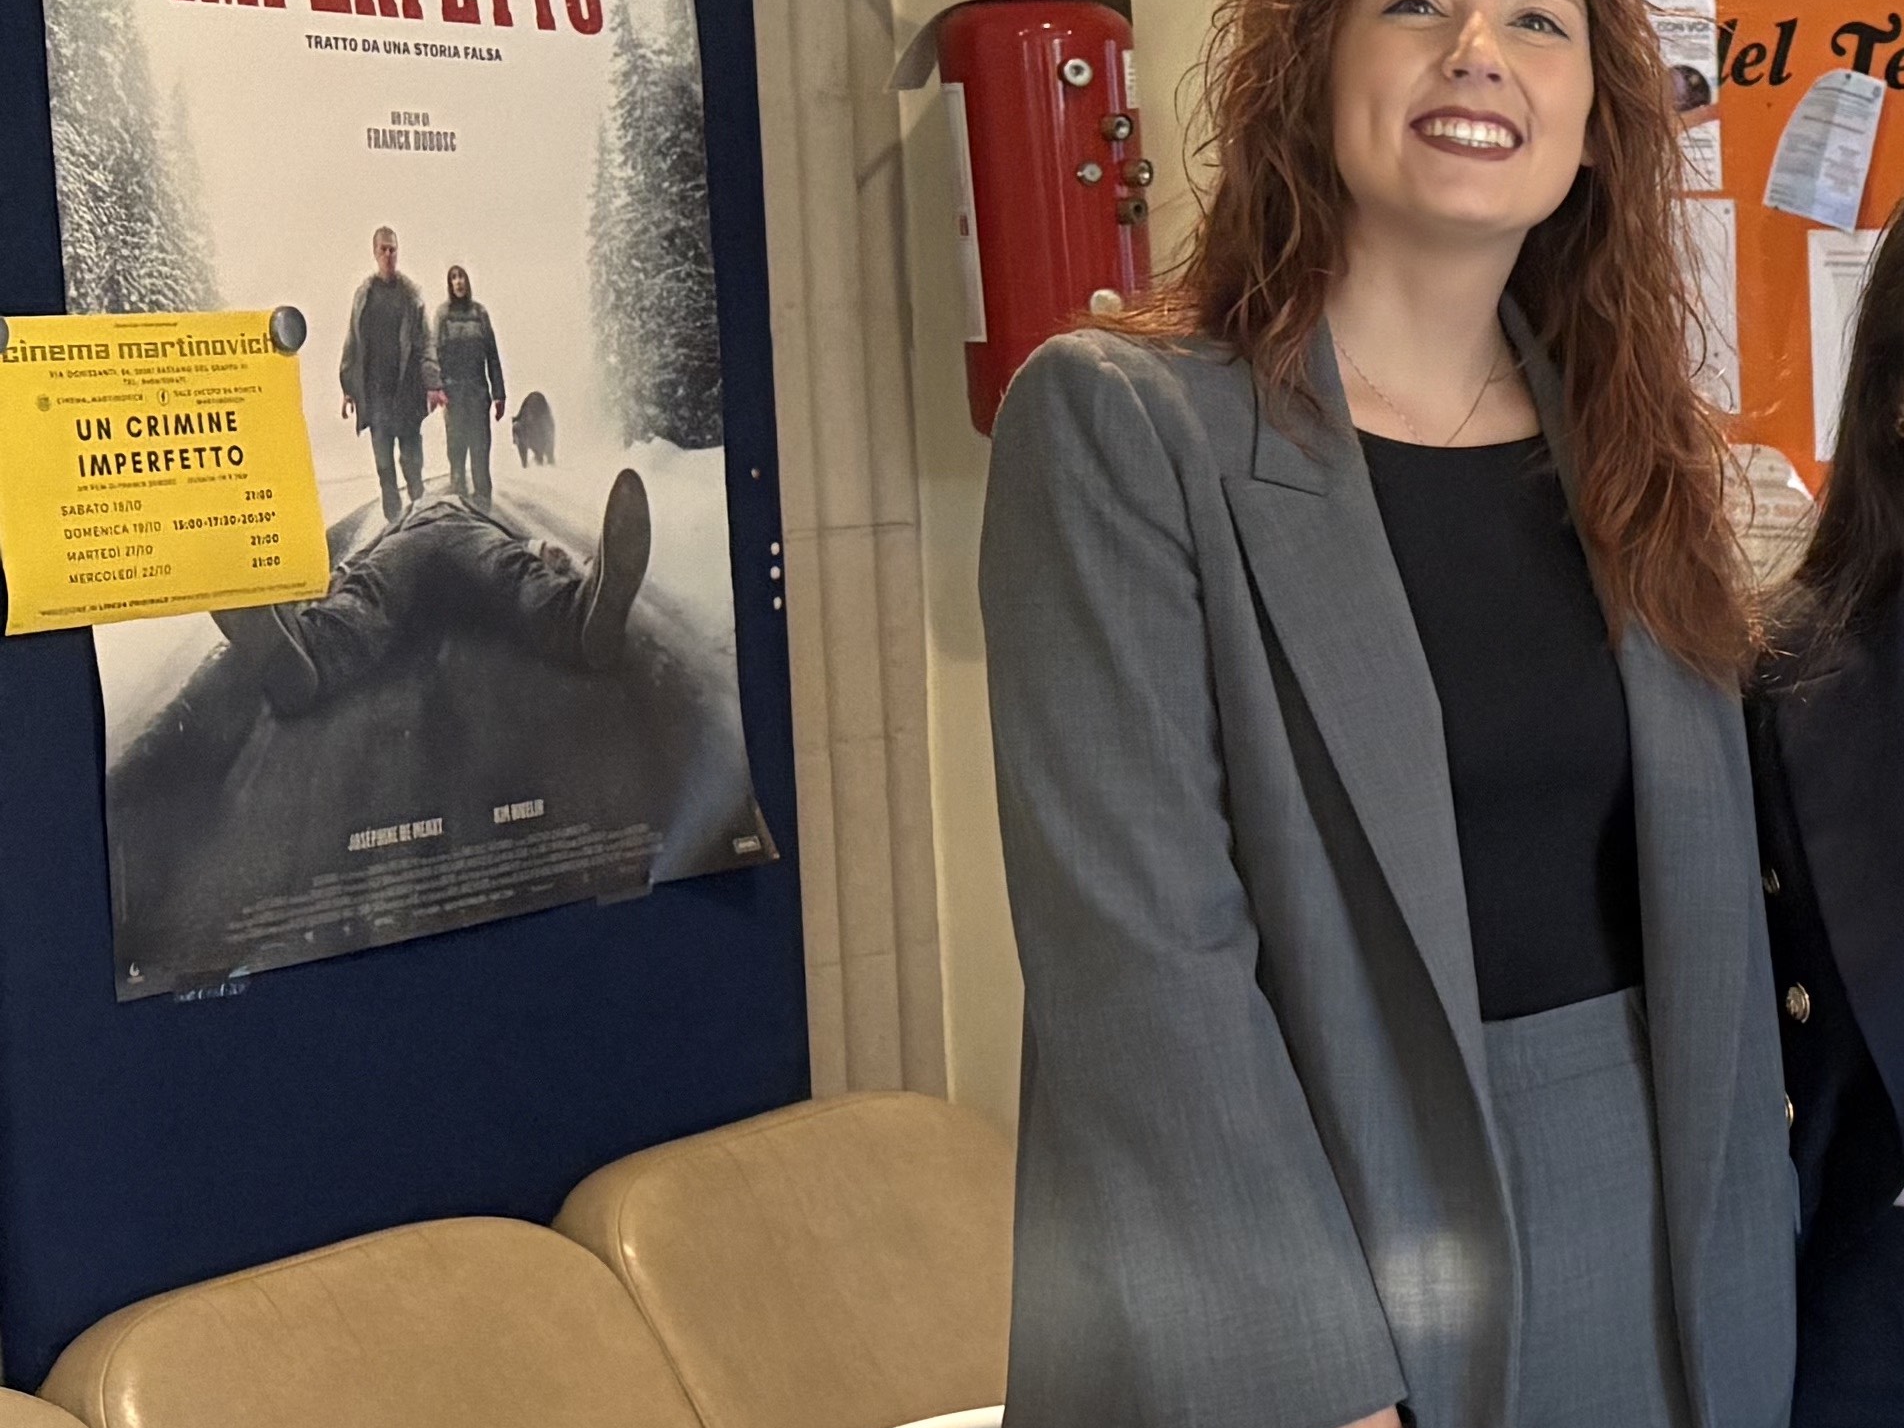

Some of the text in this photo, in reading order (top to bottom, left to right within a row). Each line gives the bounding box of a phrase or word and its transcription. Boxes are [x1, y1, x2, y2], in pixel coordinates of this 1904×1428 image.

[305, 35, 502, 61] TRATTO DA UNA STORIA FALSA
[2, 339, 110, 363] cinema
[76, 410, 238, 441] UN CRIMINE
[78, 444, 244, 478] IMPERFETTO
[61, 501, 109, 517] SABATO
[64, 523, 130, 540] DOMENICA
[67, 544, 121, 562] MARTEDÌ
[69, 565, 138, 584] MERCOLEDÌ
